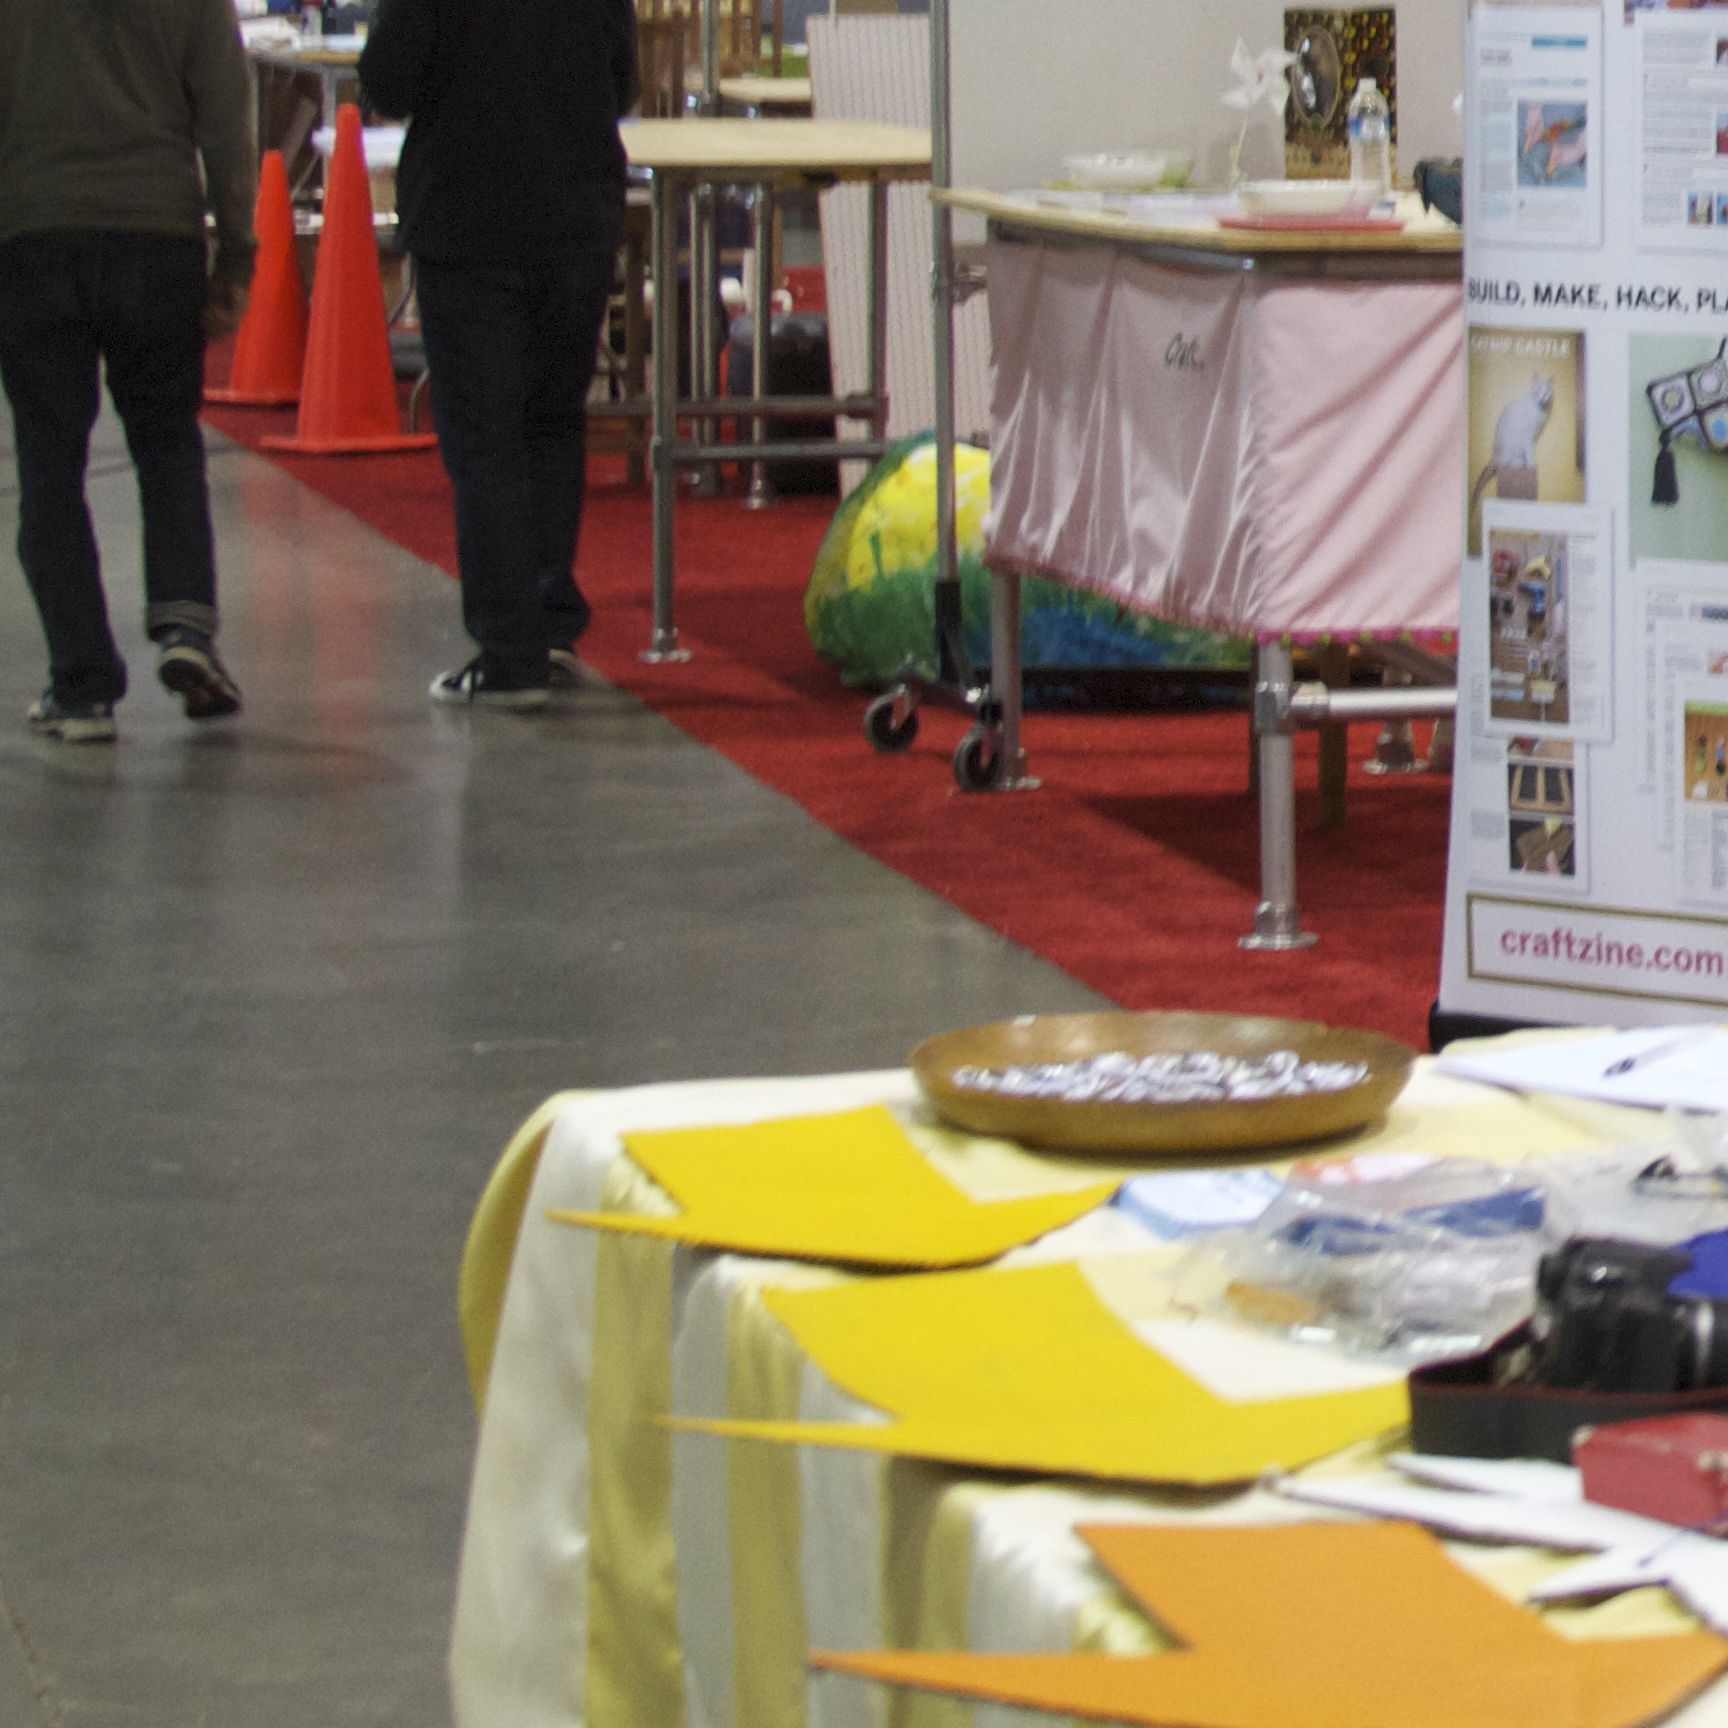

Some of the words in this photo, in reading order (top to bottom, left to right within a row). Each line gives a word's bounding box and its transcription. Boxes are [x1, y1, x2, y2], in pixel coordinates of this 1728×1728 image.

[1533, 280, 1608, 312] MAKE,
[1616, 284, 1690, 315] HACK,
[1501, 926, 1724, 976] craftzine.com
